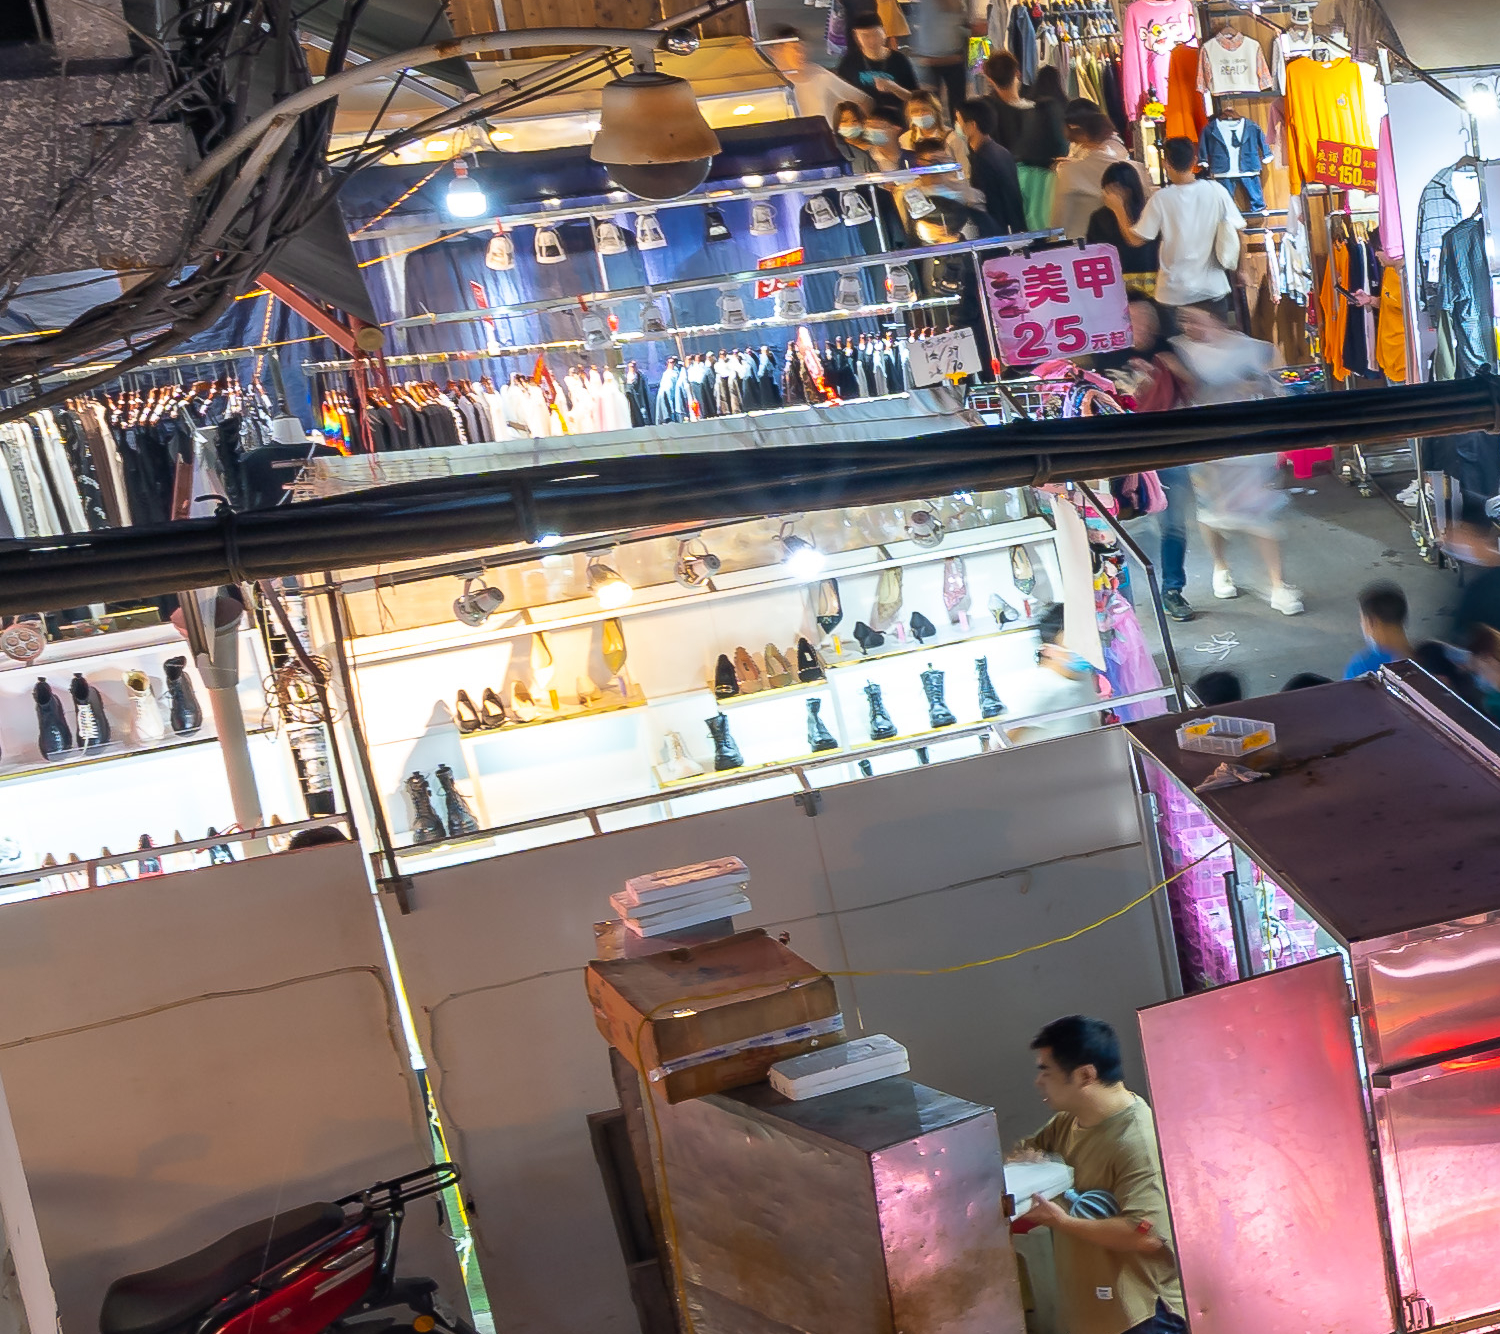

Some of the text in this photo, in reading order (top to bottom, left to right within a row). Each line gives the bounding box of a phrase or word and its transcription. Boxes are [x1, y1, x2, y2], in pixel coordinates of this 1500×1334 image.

[1342, 146, 1362, 167] 80
[1338, 165, 1362, 187] 150
[1021, 254, 1118, 310] 美甲
[1013, 314, 1128, 359] 25 元起
